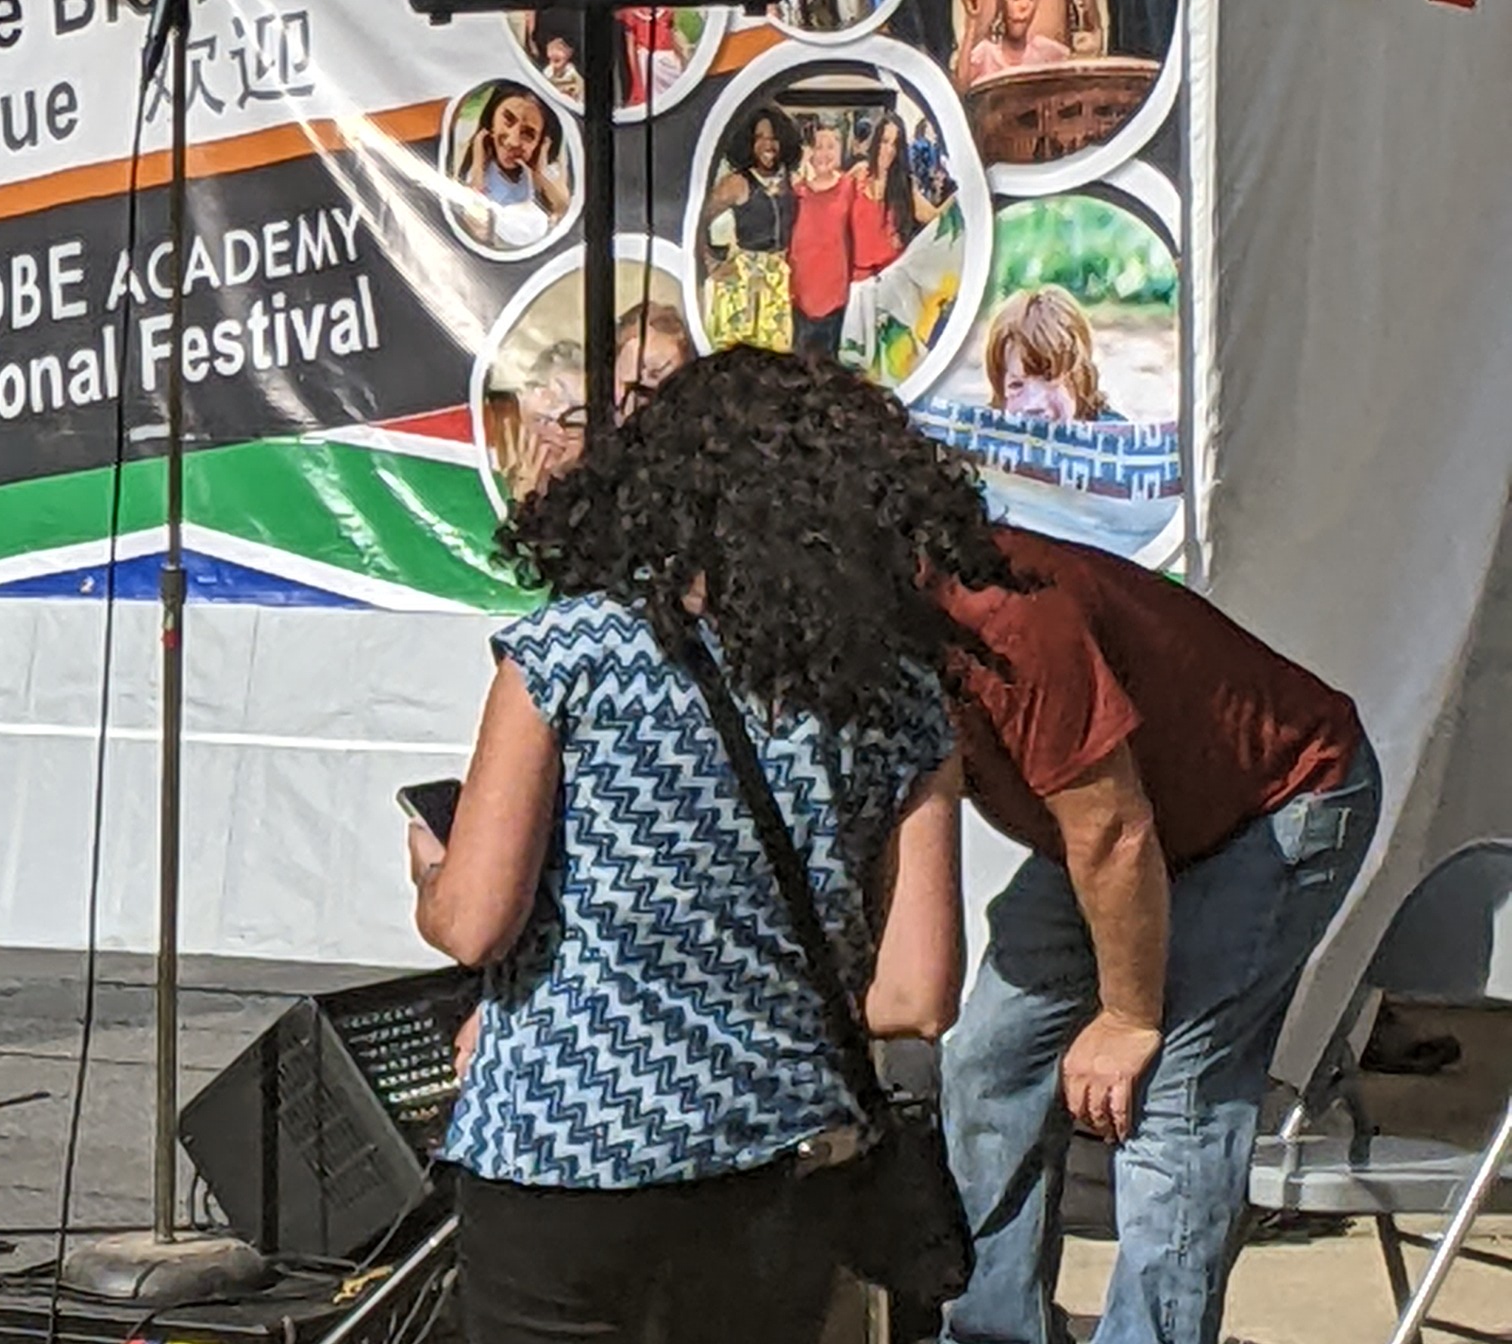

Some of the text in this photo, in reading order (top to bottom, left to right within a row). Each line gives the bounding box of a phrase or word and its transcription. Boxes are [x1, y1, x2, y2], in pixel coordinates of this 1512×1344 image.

[144, 9, 315, 123] 欢迎
[106, 206, 362, 311] ACADEMY
[139, 274, 380, 392] Festival
